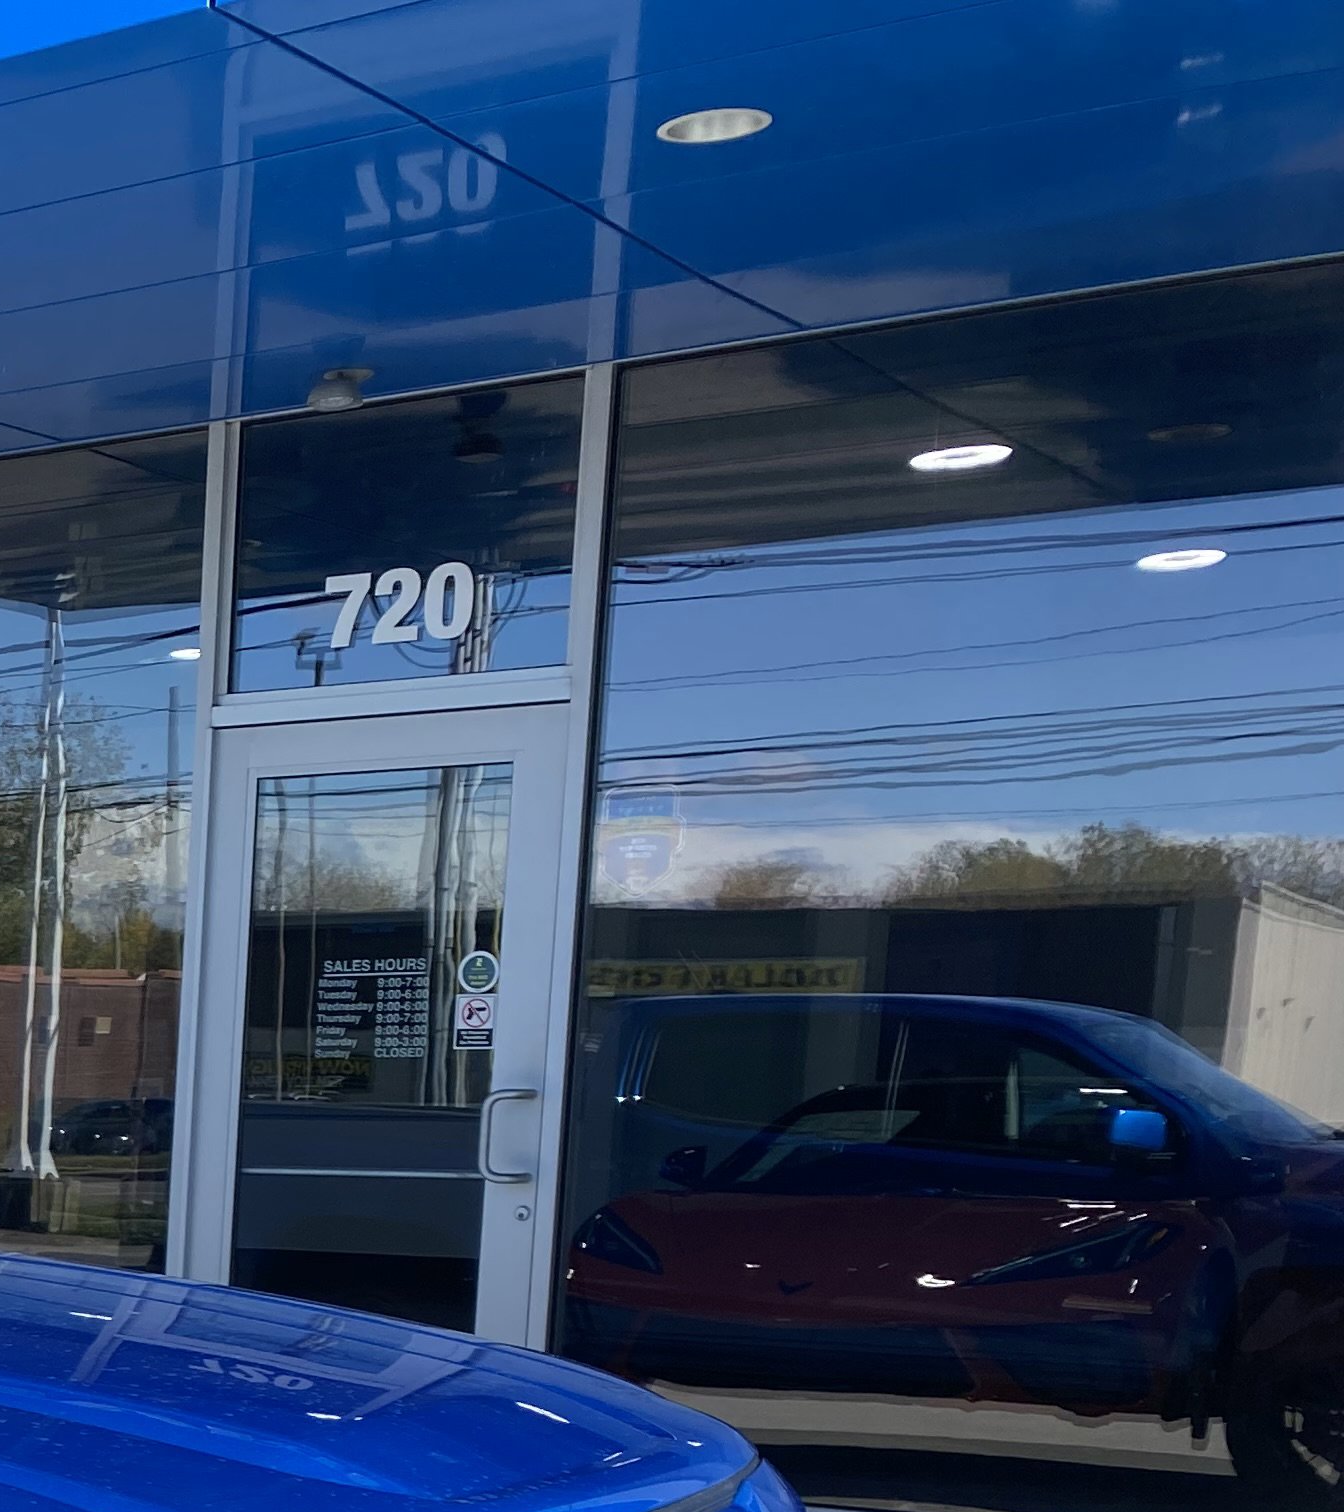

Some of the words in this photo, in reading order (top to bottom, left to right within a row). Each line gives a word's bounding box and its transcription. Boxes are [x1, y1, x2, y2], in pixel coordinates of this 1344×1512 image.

[324, 561, 474, 649] 720
[323, 959, 372, 972] SALES
[374, 957, 427, 971] HOURS
[374, 1047, 424, 1058] CLOSED
